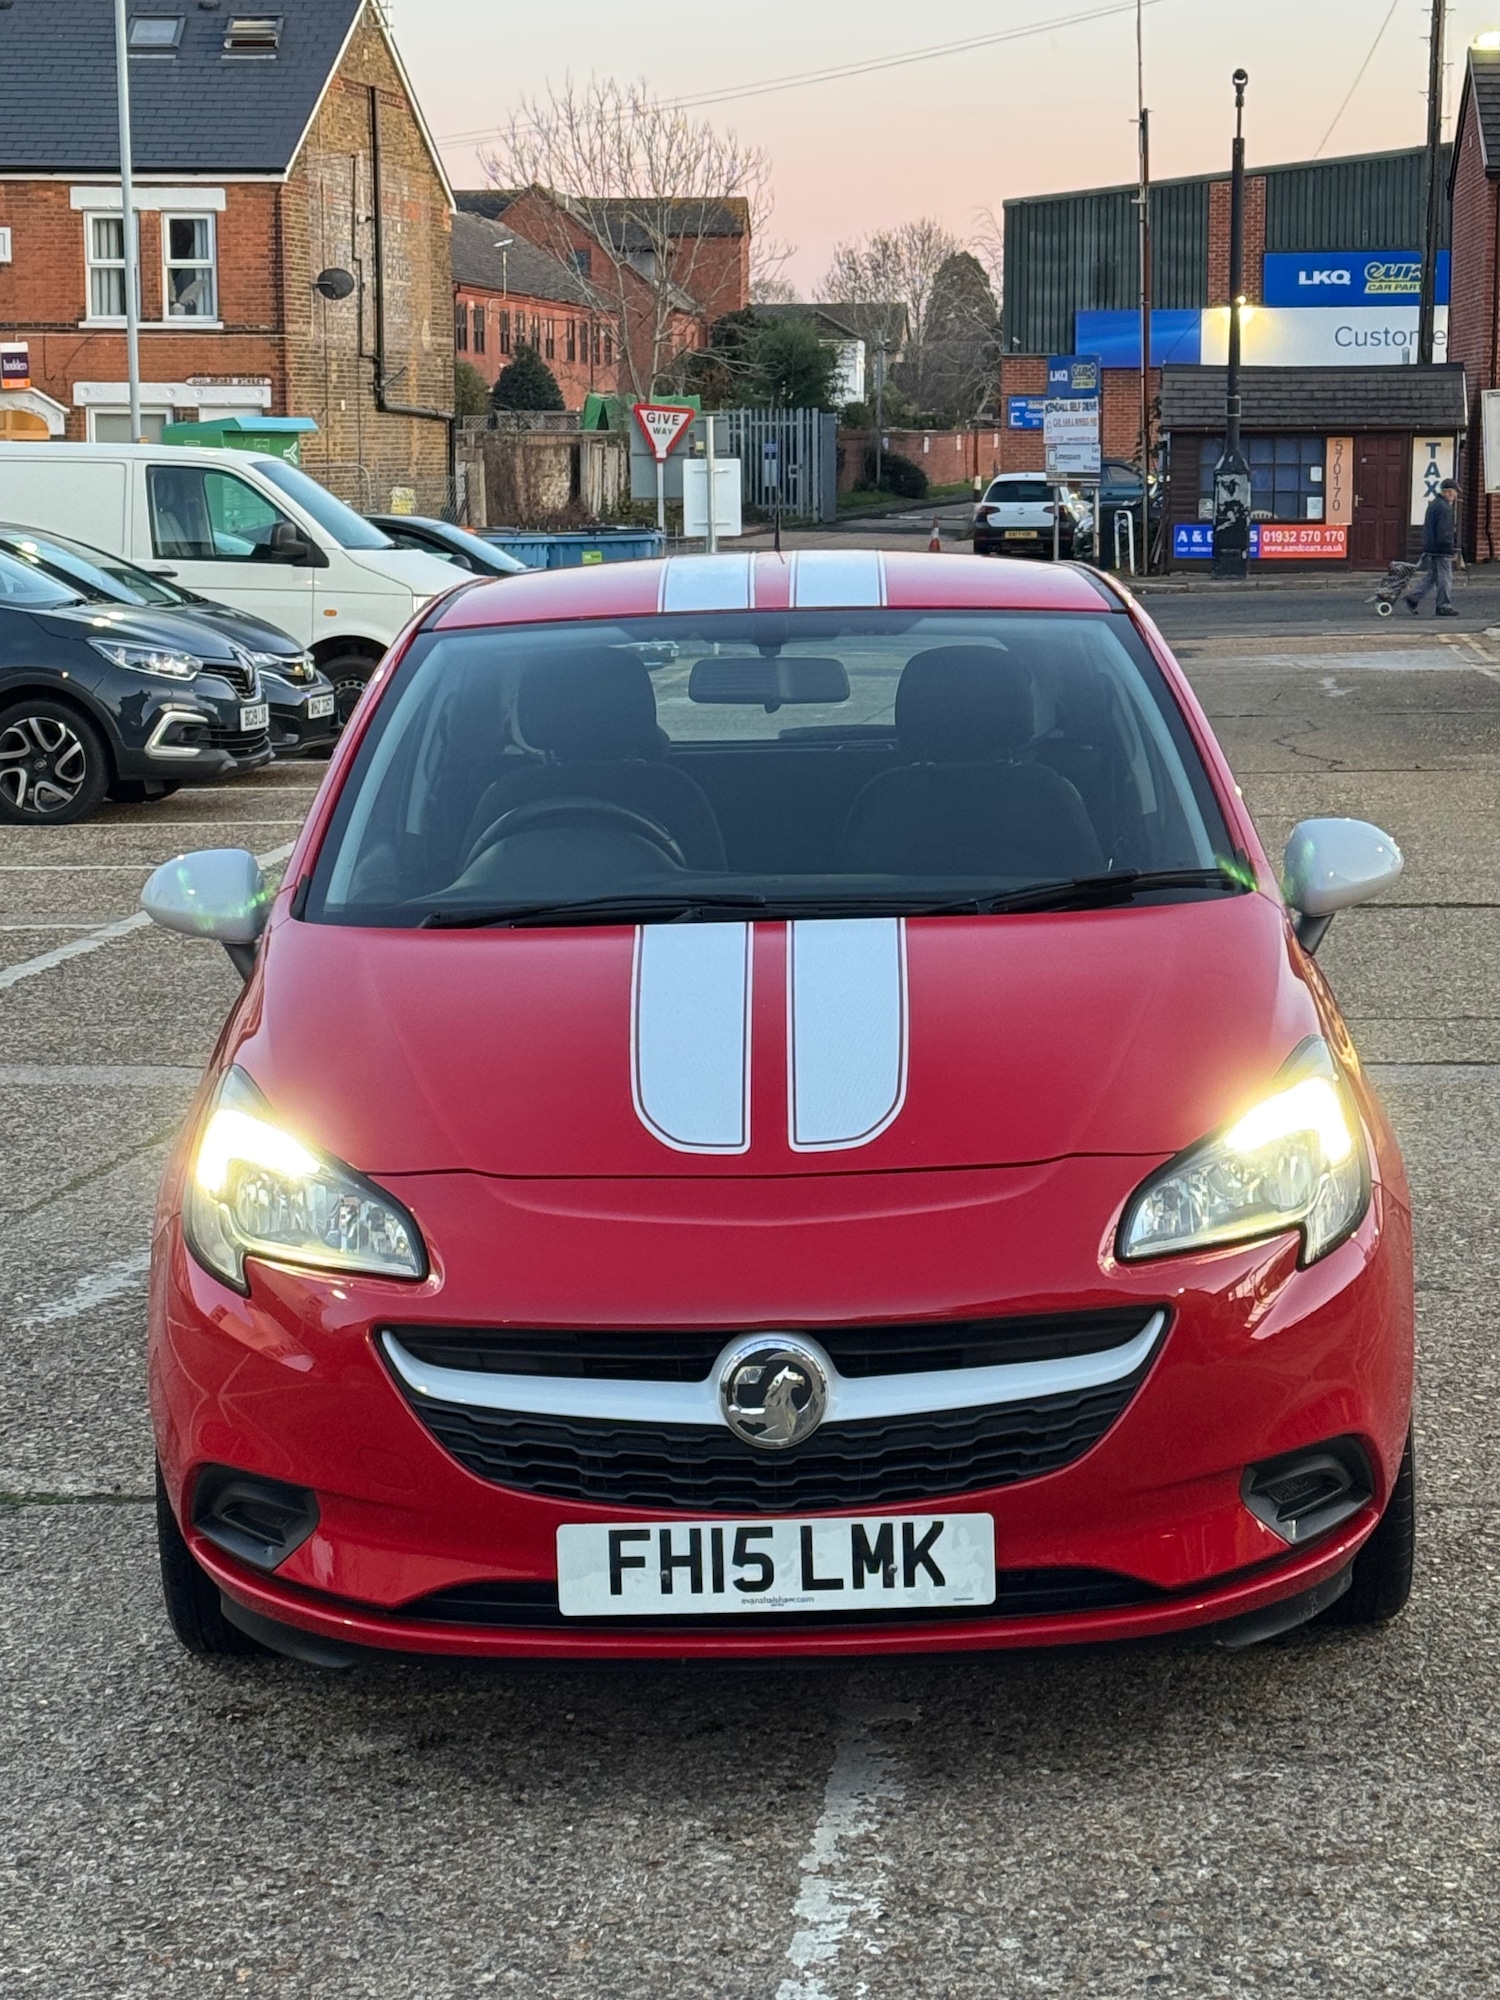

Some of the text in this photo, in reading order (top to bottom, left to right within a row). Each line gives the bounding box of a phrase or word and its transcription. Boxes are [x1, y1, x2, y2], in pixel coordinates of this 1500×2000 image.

[1299, 270, 1350, 285] LKQ
[1364, 261, 1422, 282] eur
[1049, 370, 1069, 382] LKQ
[646, 412, 680, 425] GIVE
[1024, 411, 1044, 419] Good
[652, 427, 673, 436] WAY
[1332, 440, 1344, 511] 570170
[1423, 442, 1442, 498] TAX
[1177, 531, 1188, 543] A
[1192, 531, 1203, 542] &
[1263, 530, 1296, 543] 01932
[1300, 530, 1321, 543] 570
[1324, 530, 1345, 543] 170
[608, 1521, 945, 1595] FH15 LMK
